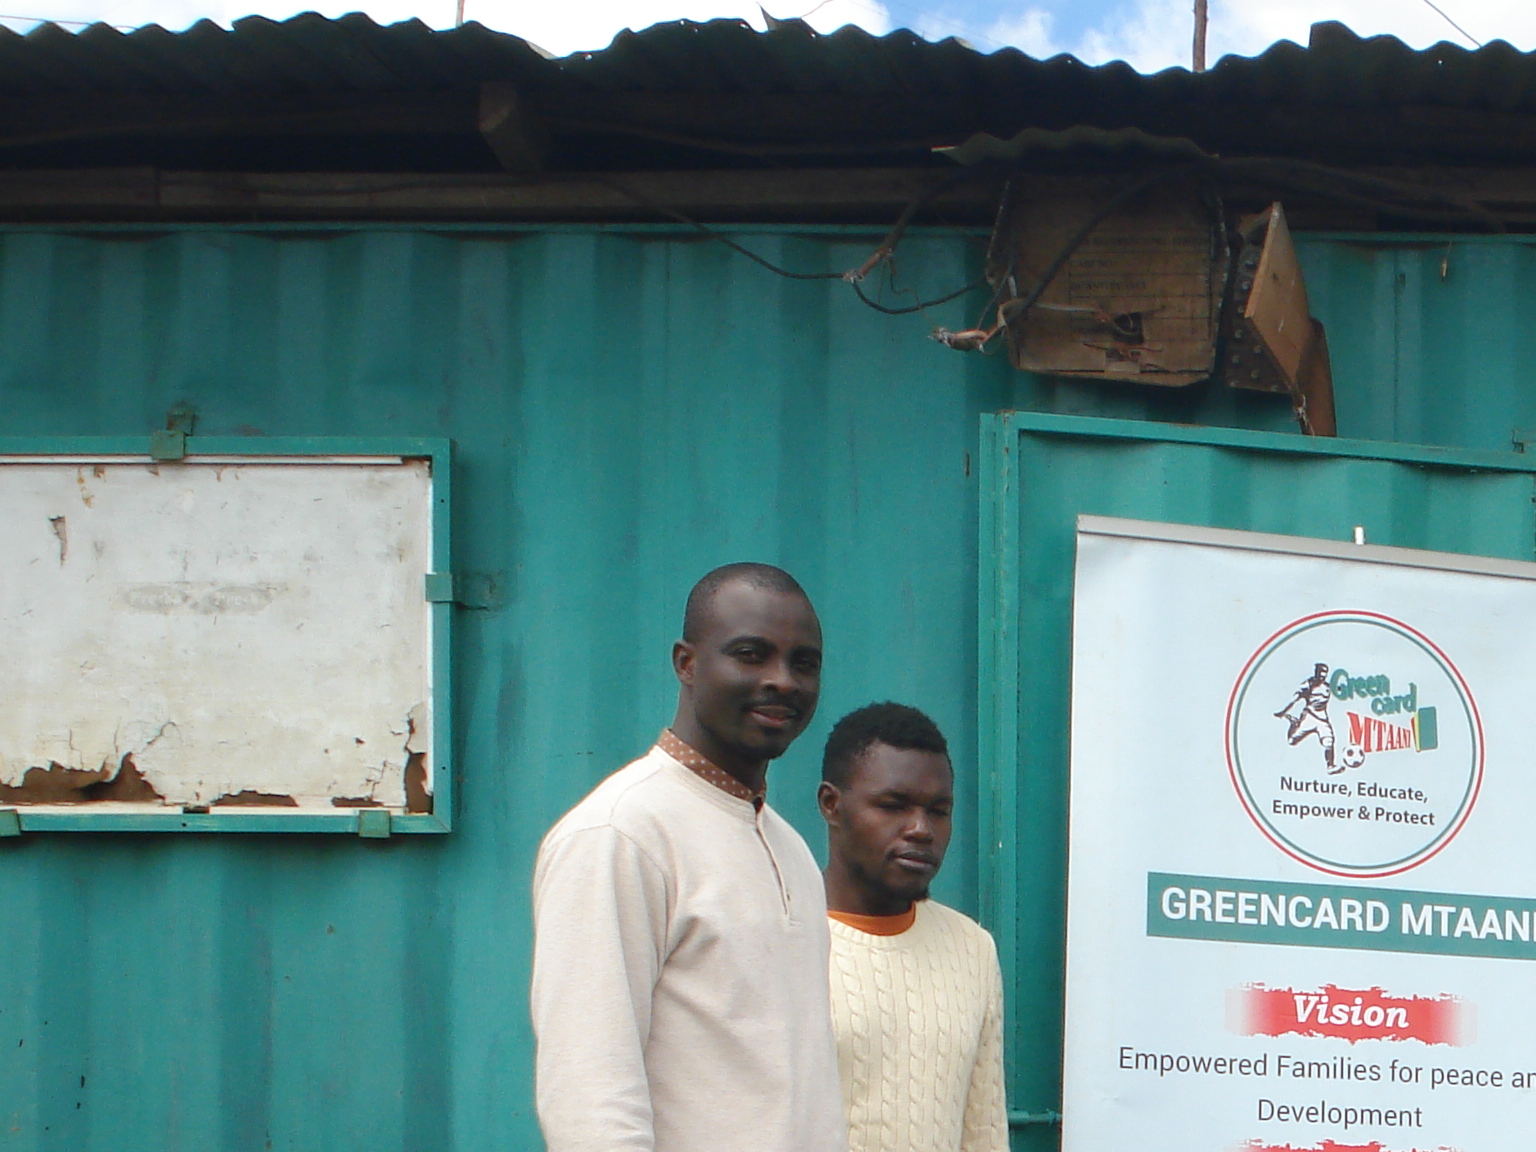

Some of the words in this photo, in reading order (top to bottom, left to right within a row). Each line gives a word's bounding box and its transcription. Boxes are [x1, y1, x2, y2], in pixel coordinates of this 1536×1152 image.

[1331, 668, 1390, 700] Green
[1371, 682, 1417, 716] card
[1281, 777, 1351, 797] Nurture,
[1358, 782, 1427, 803] Educate,
[1273, 800, 1353, 819] Empower
[1358, 806, 1370, 820] &
[1376, 807, 1434, 825] Protect
[1162, 887, 1389, 931] GREENCARD
[1294, 995, 1409, 1027] Vision
[1120, 1047, 1267, 1076] Empowered
[1278, 1056, 1380, 1081] Families
[1390, 1059, 1423, 1083] for
[1432, 1068, 1503, 1089] peace
[1259, 1099, 1422, 1129] Development
